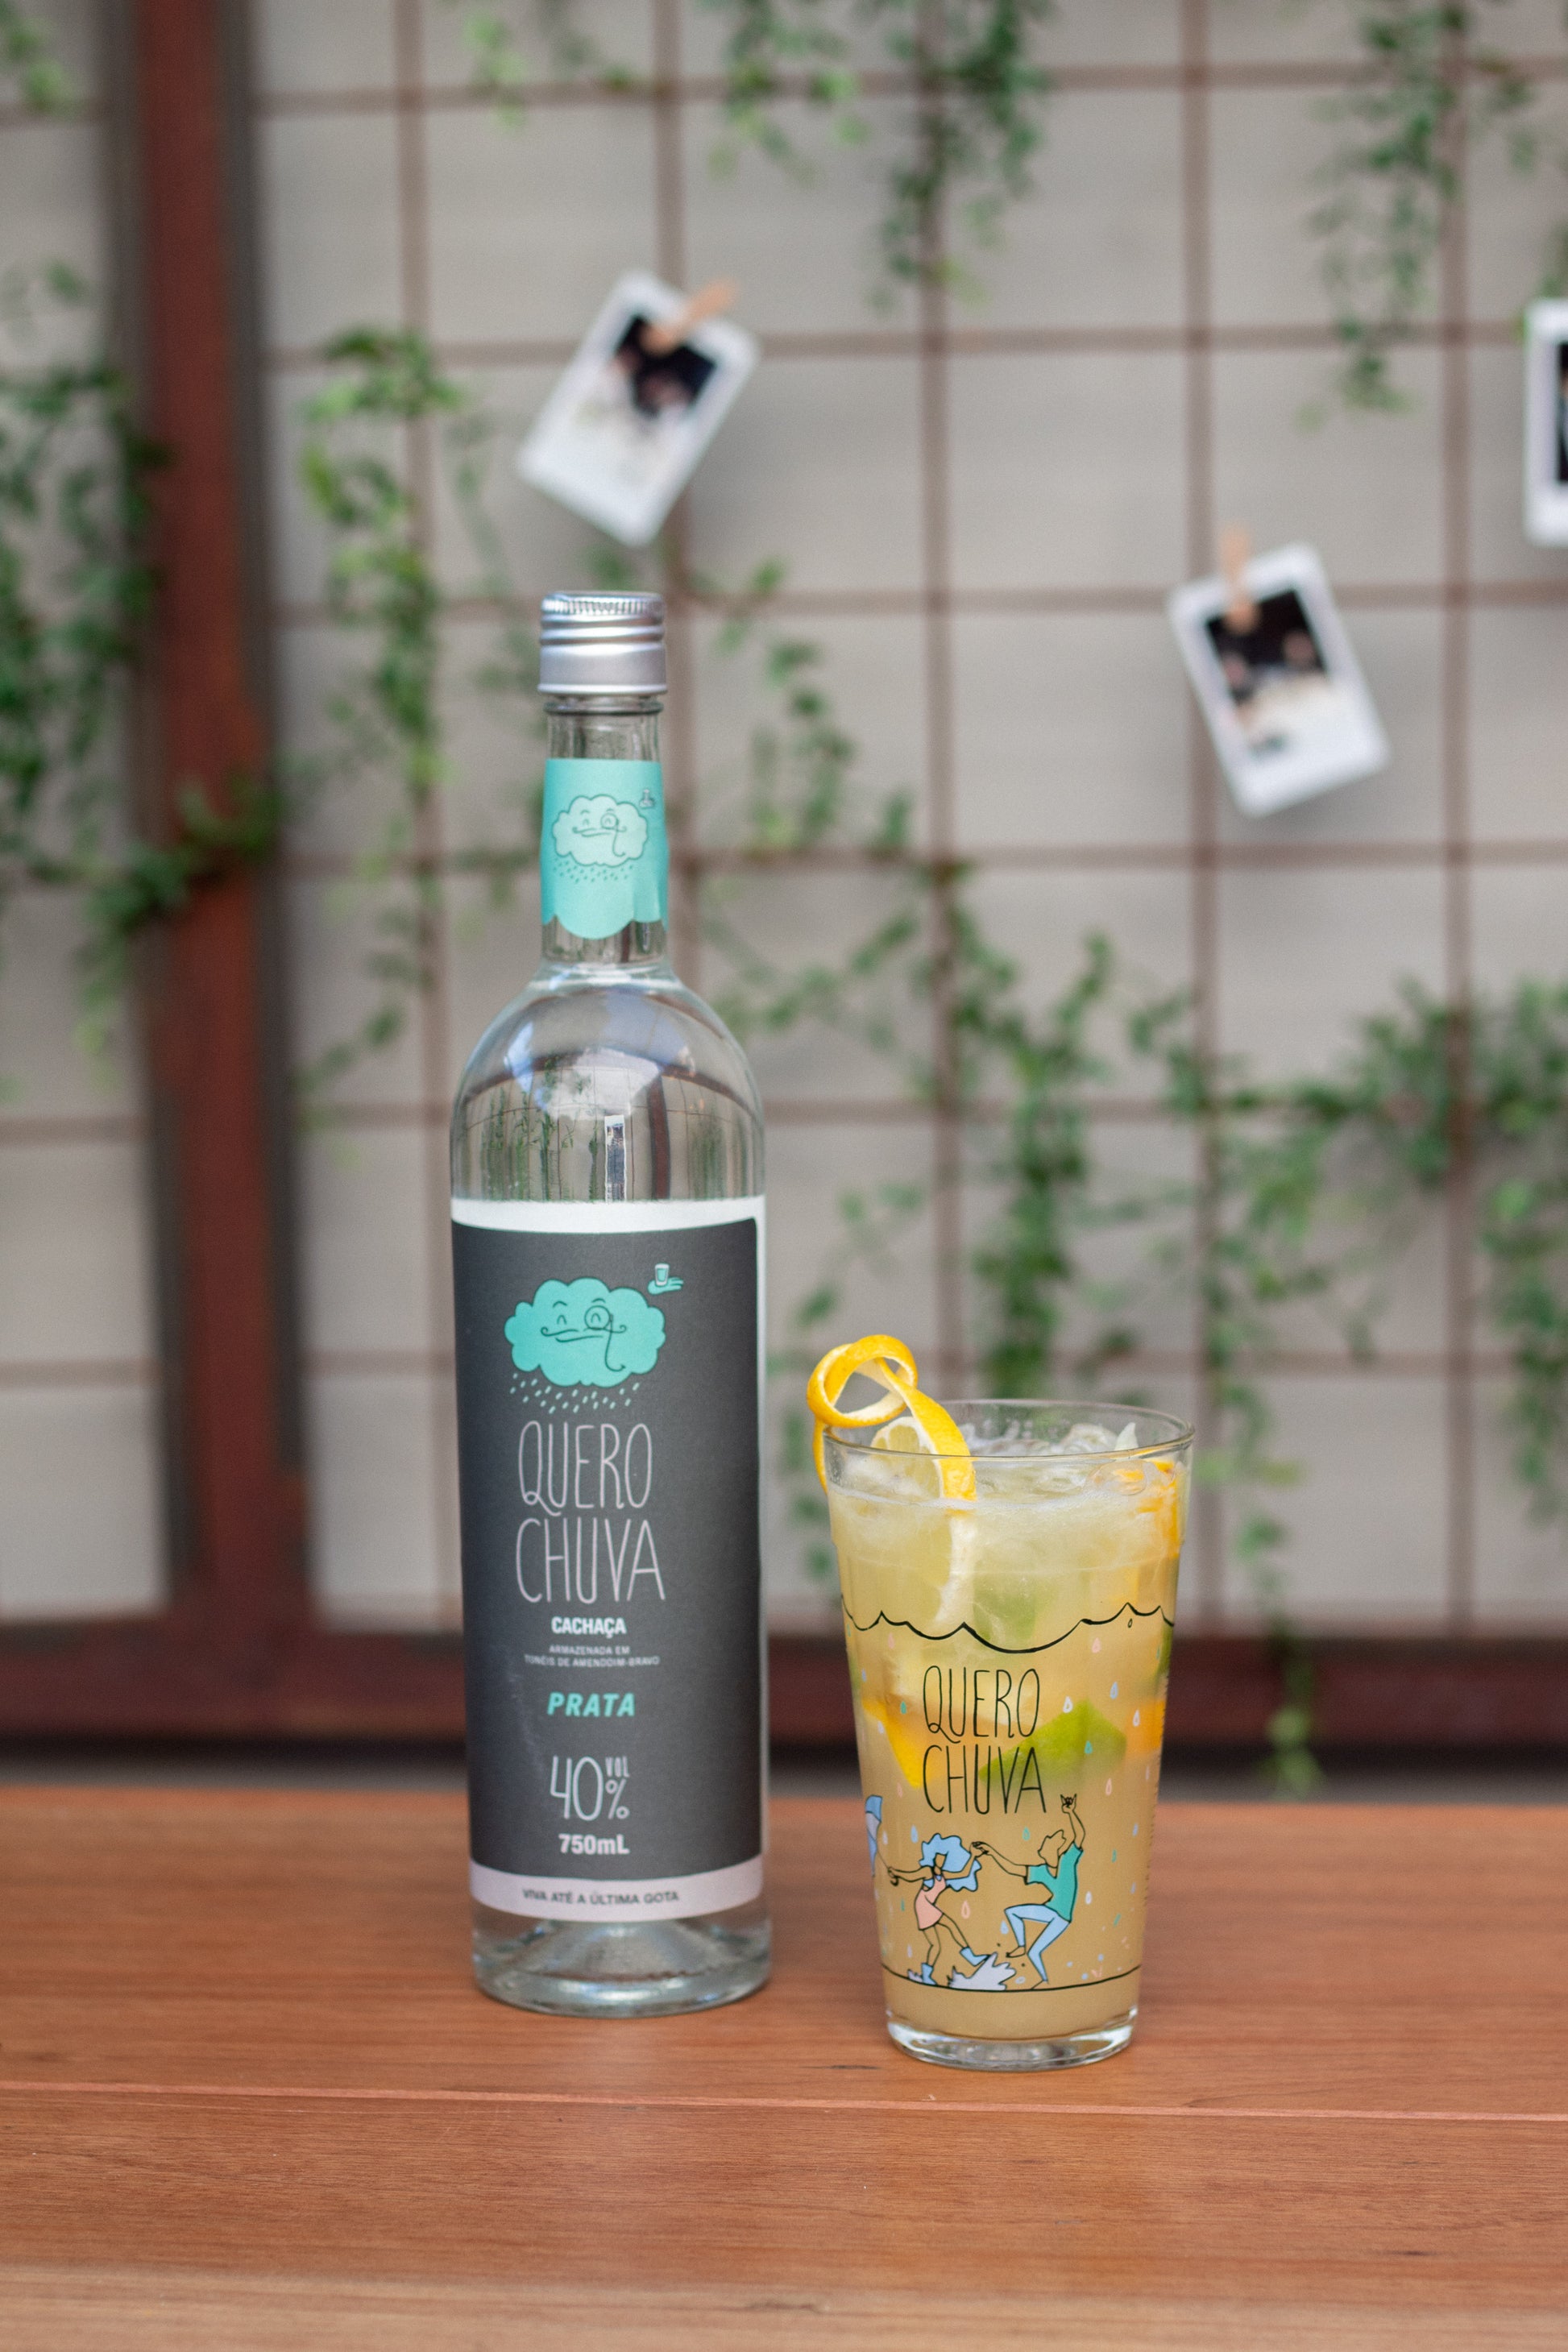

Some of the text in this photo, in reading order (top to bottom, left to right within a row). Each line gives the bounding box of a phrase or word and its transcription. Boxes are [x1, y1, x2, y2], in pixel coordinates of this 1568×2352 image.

[518, 1421, 652, 1516] QUERO
[516, 1517, 666, 1603] CHUVA
[551, 1616, 627, 1638] CACHAÇA
[524, 1654, 661, 1667] TONÉIS DE AMENDOIM-BRAVO
[549, 1645, 631, 1655] ARMAZENADA EM
[547, 1691, 635, 1717] PRATA
[923, 1665, 1041, 1743] QUERO
[604, 1756, 630, 1777] VOL
[923, 1744, 1047, 1815] CHUVA
[558, 1833, 630, 1855] 750mL
[522, 1889, 679, 1905] VIVA ATÉ A ÚLTIMA GOTA
